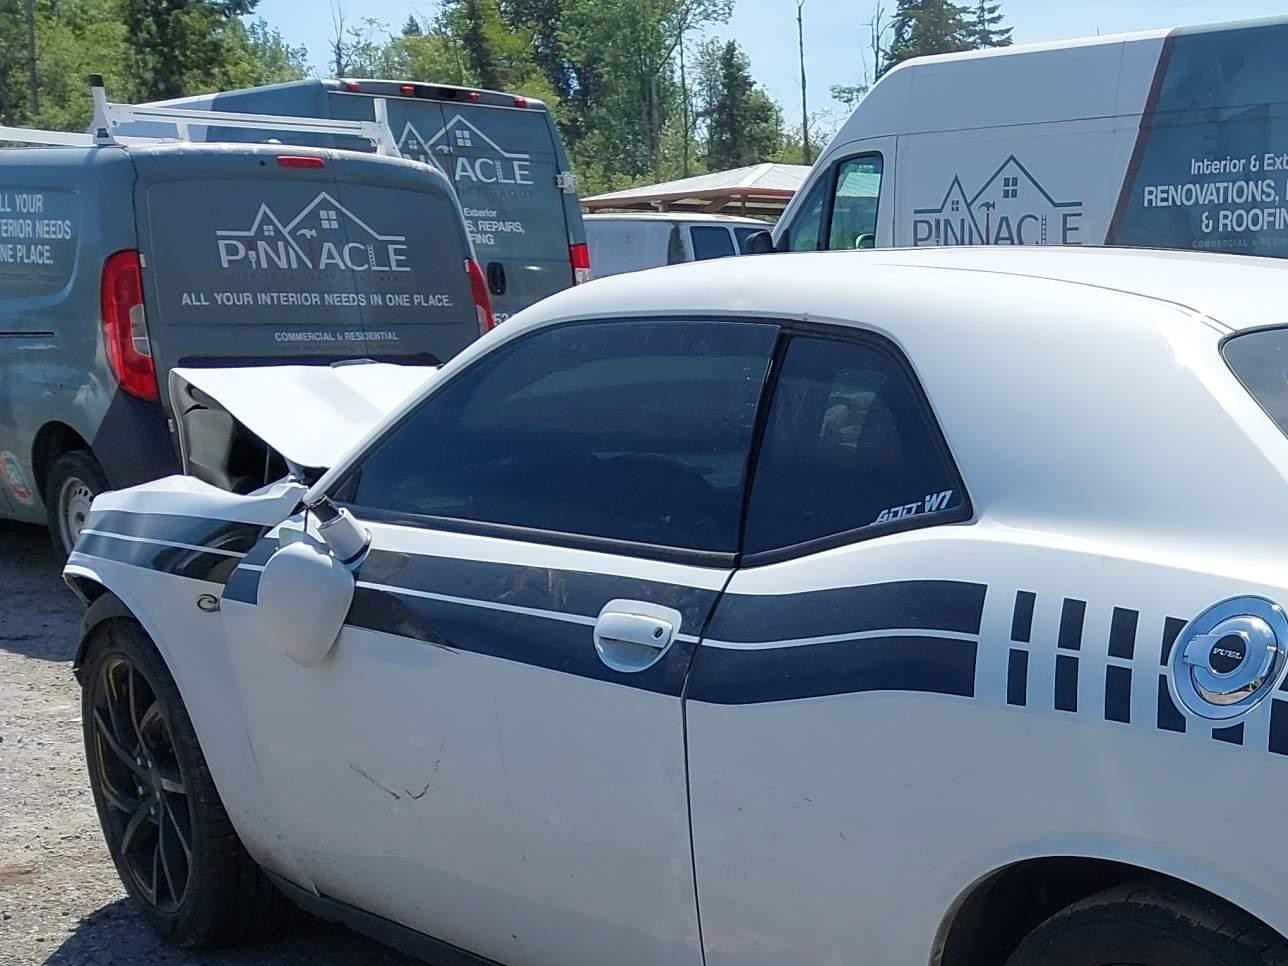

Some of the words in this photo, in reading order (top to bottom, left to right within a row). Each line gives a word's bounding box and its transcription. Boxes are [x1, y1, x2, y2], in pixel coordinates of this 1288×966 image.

[1190, 157, 1246, 175] Interior
[1250, 155, 1259, 171] &
[1143, 180, 1279, 207] RENOVATIONS,
[0, 194, 11, 212] LL
[15, 194, 43, 213] YOUR
[464, 207, 497, 217] Exterior
[0, 219, 32, 238] ERIOR
[36, 220, 71, 239] NEEDS
[478, 220, 525, 234] REPAIRS,
[1201, 212, 1213, 233] &
[469, 233, 494, 245] FING
[0, 244, 14, 262] NE
[17, 244, 54, 264] PLACE.
[217, 239, 411, 271] PINNACLE
[181, 293, 210, 305] ALL
[214, 293, 253, 305] YOUR
[258, 293, 321, 306] INTERIOR
[324, 293, 366, 306] NEEDS
[370, 293, 383, 305] IN
[385, 294, 410, 306] ONE
[414, 294, 453, 307] PLACE.
[275, 332, 335, 342] COMMERCIAL
[345, 331, 399, 341] RESIDENTIAL
[1212, 647, 1242, 660] FUEL
